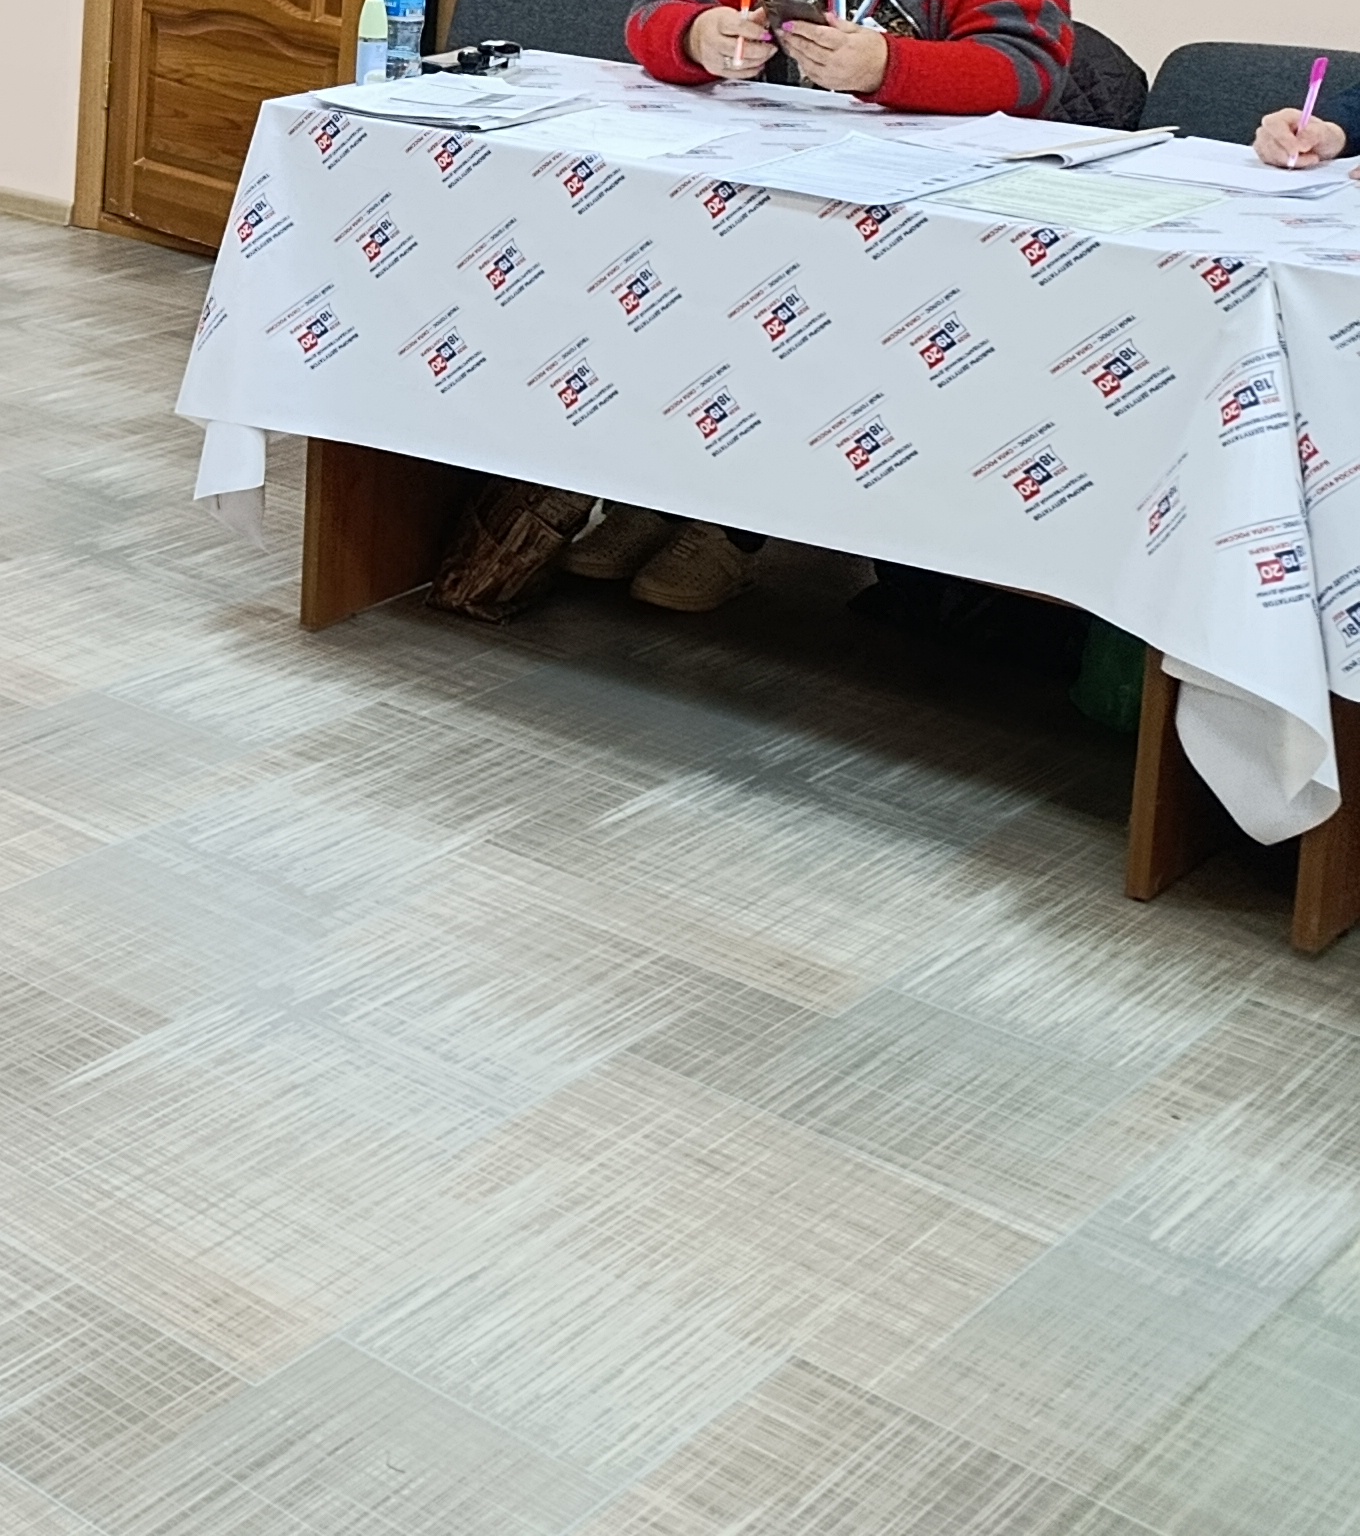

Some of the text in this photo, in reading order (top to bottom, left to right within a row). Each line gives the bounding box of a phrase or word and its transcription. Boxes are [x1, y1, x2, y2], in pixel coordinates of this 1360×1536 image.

[566, 163, 589, 193] 19 20
[706, 183, 731, 214] 19 20
[364, 216, 391, 257] 18 19 20
[858, 204, 885, 236] 19 20
[488, 243, 516, 285] 18 19 20
[1024, 227, 1054, 261] 19 20
[621, 266, 652, 310] 18 19 20
[1205, 253, 1237, 287] 19 20
[300, 308, 332, 349] 18 19 20
[765, 291, 799, 336] 18 19 20
[430, 331, 459, 372] 18 19 20
[922, 317, 959, 364] 18 19 20
[560, 362, 589, 404] 18 19 20
[1096, 344, 1136, 392] 18 19 20
[698, 390, 730, 434] 18 19 20
[1223, 378, 1272, 420] 18 19 20
[848, 420, 883, 465] 18 19 20
[1017, 450, 1055, 496] 18 19 20
[1260, 554, 1300, 580] 19 20
[1342, 623, 1358, 639] 18
